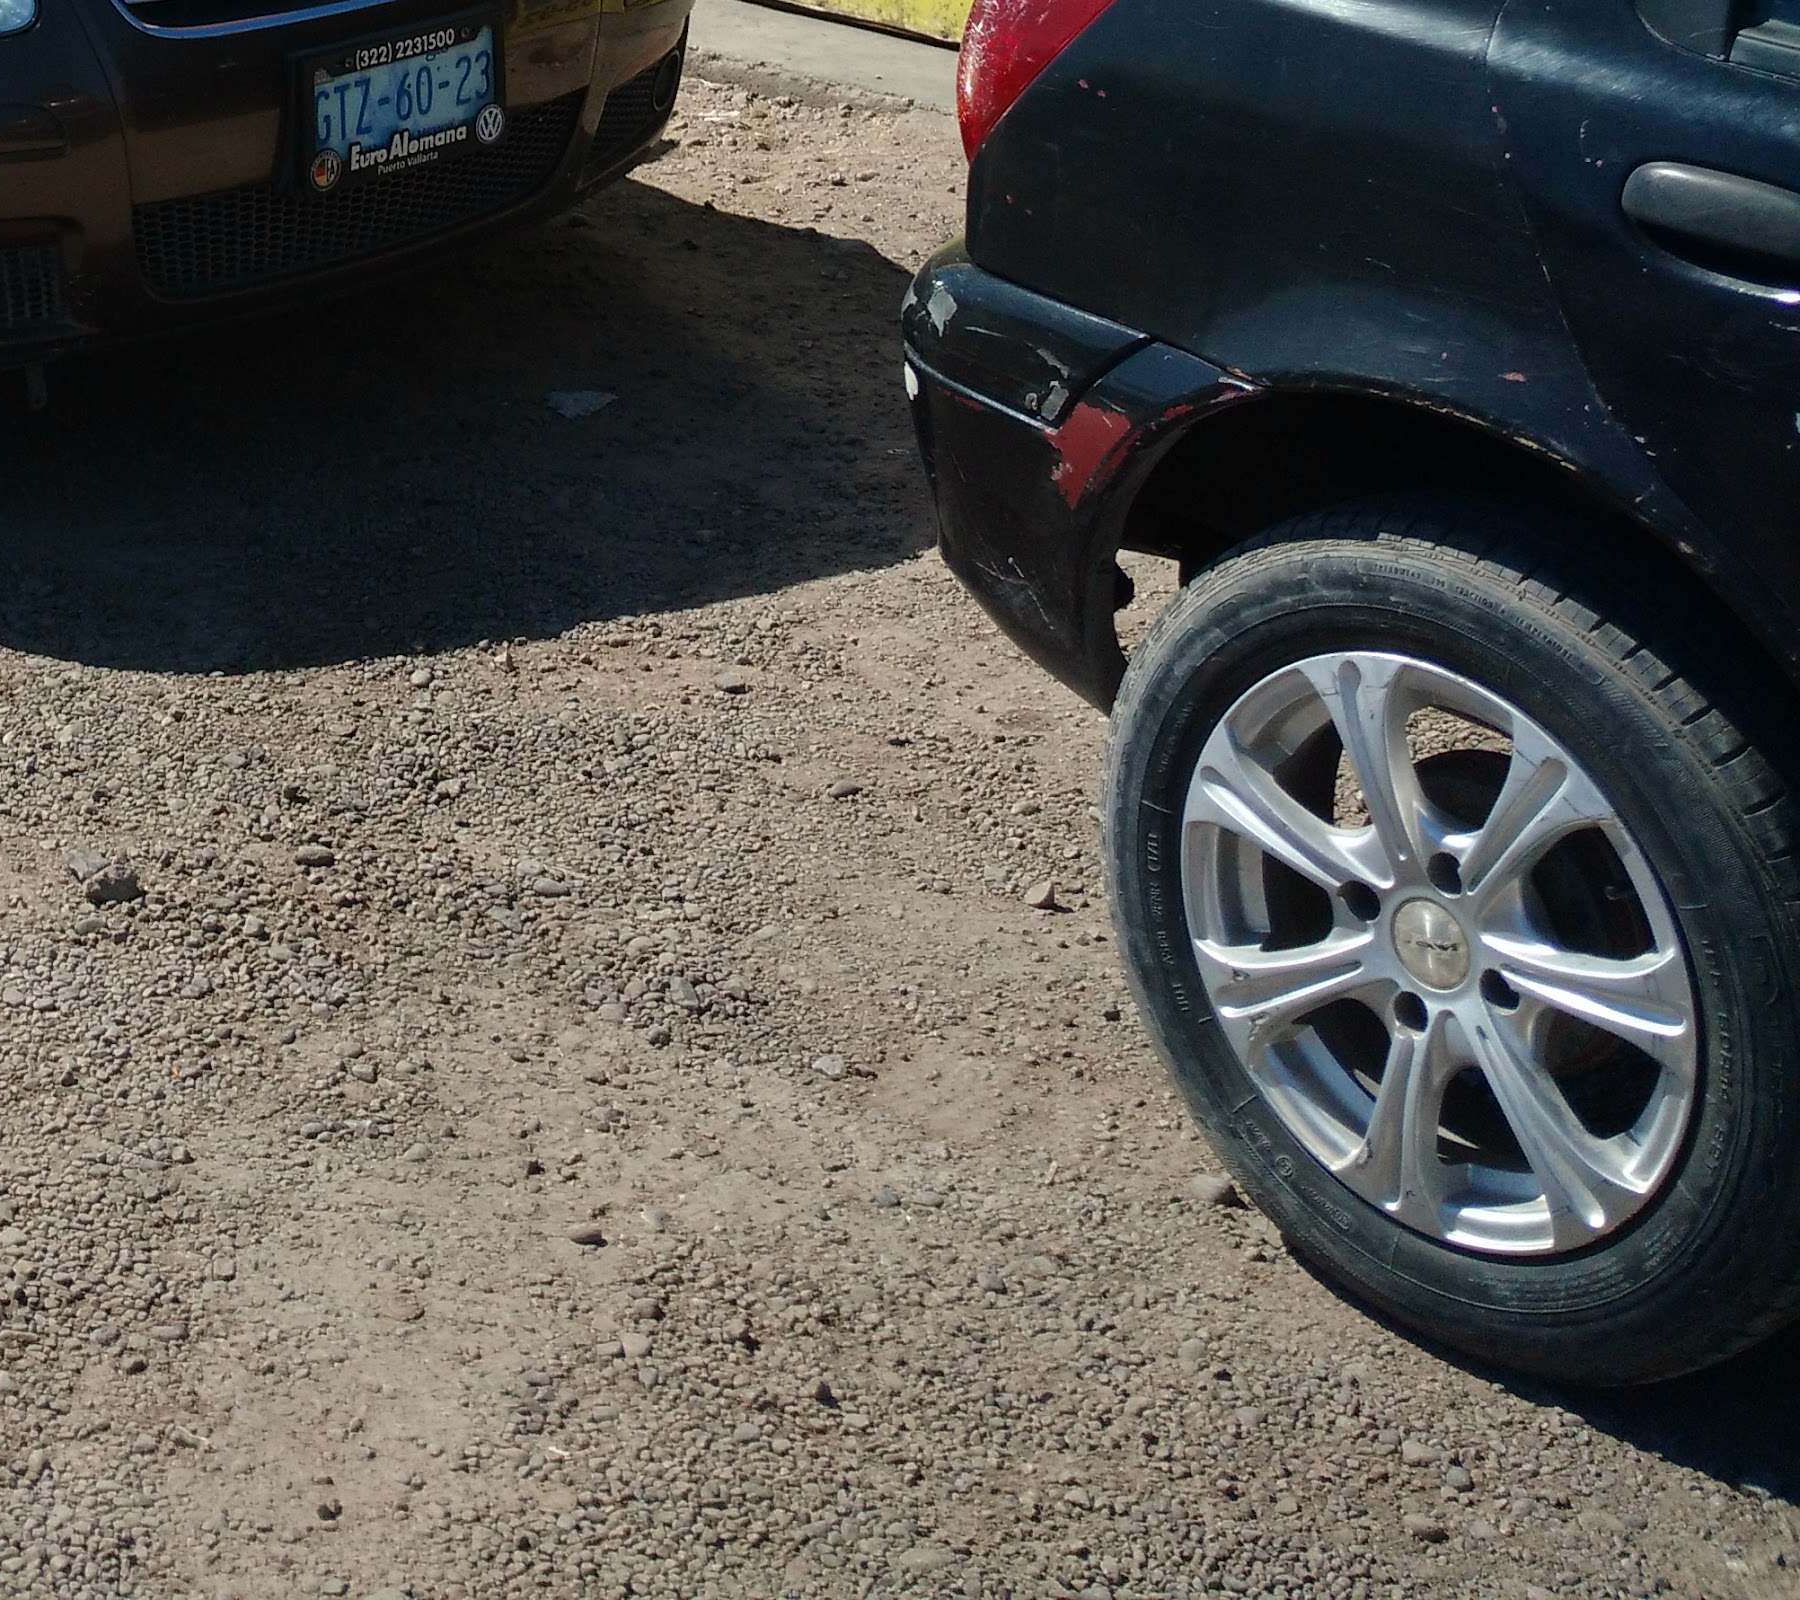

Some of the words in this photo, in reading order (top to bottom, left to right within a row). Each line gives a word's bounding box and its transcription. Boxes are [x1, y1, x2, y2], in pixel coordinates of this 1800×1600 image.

[355, 42, 393, 71] (322)
[395, 27, 455, 59] 2231500
[350, 143, 388, 171] Euro
[377, 161, 406, 176] Puerto
[407, 150, 439, 168] Vallarta
